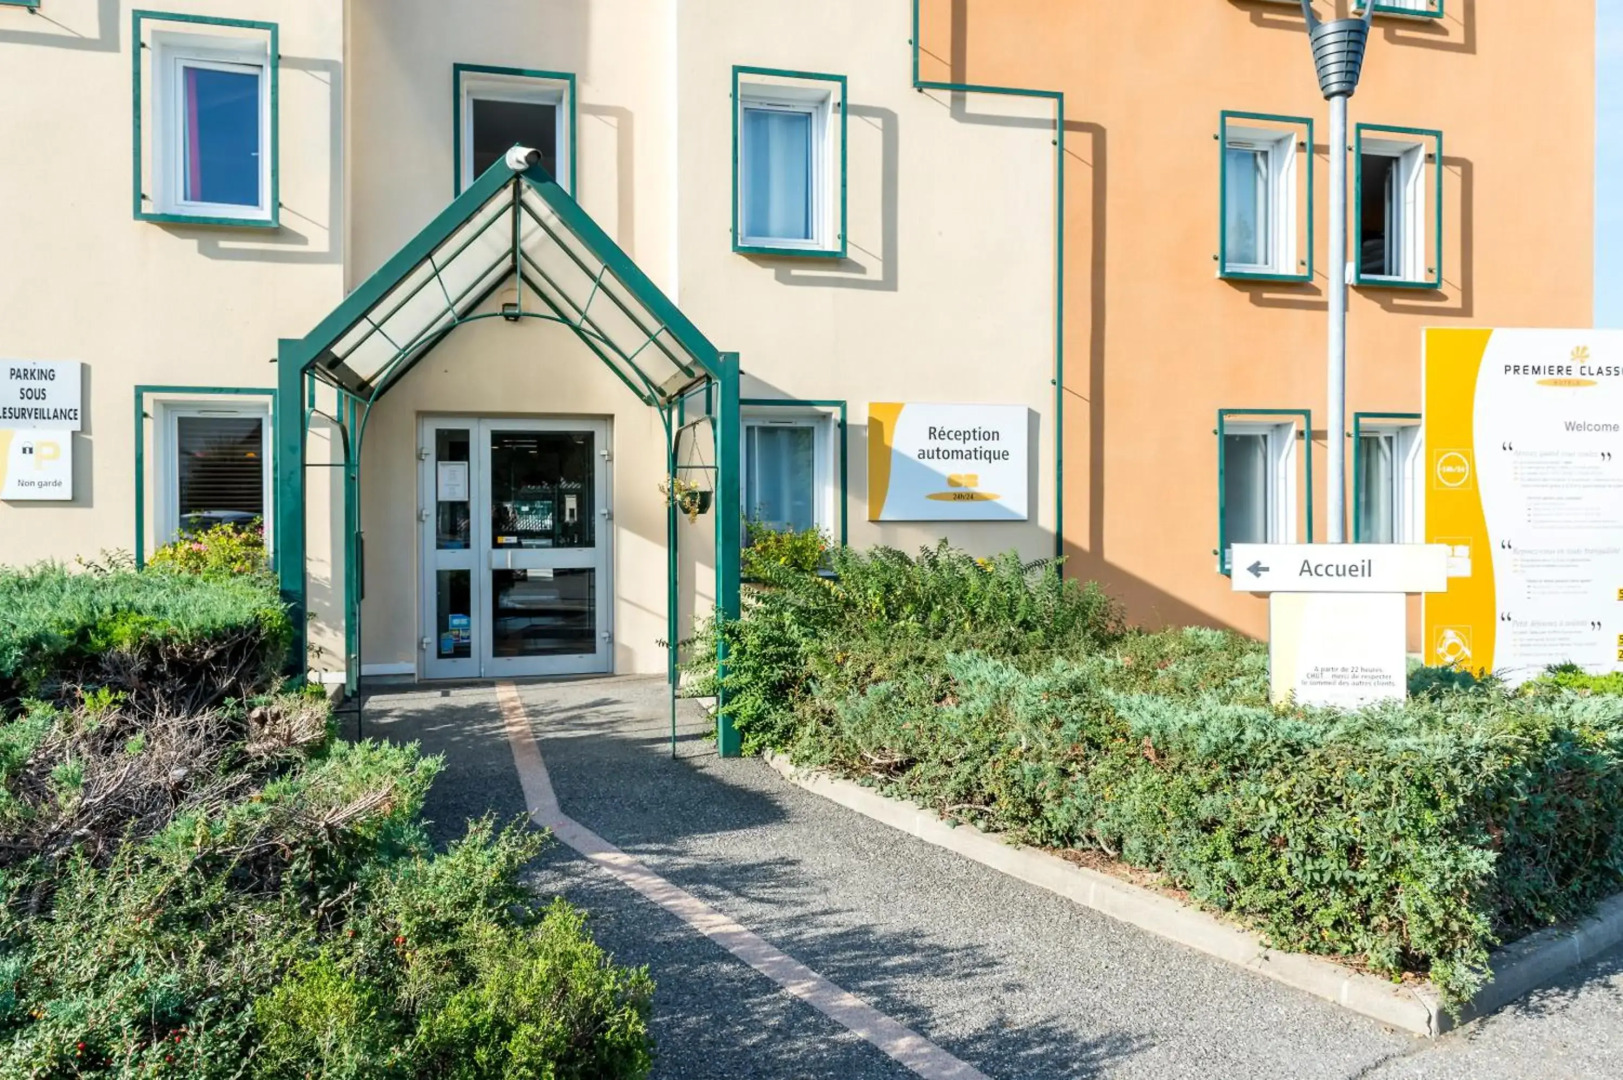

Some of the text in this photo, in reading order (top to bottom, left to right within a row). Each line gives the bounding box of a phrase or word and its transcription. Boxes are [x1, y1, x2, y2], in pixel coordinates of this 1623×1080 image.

[9, 367, 56, 381] PARKING
[1504, 364, 1623, 377] PREMIERE CLASS
[19, 387, 47, 400] SOUS
[0, 406, 79, 421] ESURVEILLANCE
[1564, 420, 1620, 432] Welcome
[928, 425, 1000, 444] Réception
[917, 446, 1010, 463] automatique
[17, 479, 35, 487] Non
[953, 492, 974, 501] 24h/24
[1299, 559, 1372, 577] Accueil
[1338, 680, 1350, 688] des
